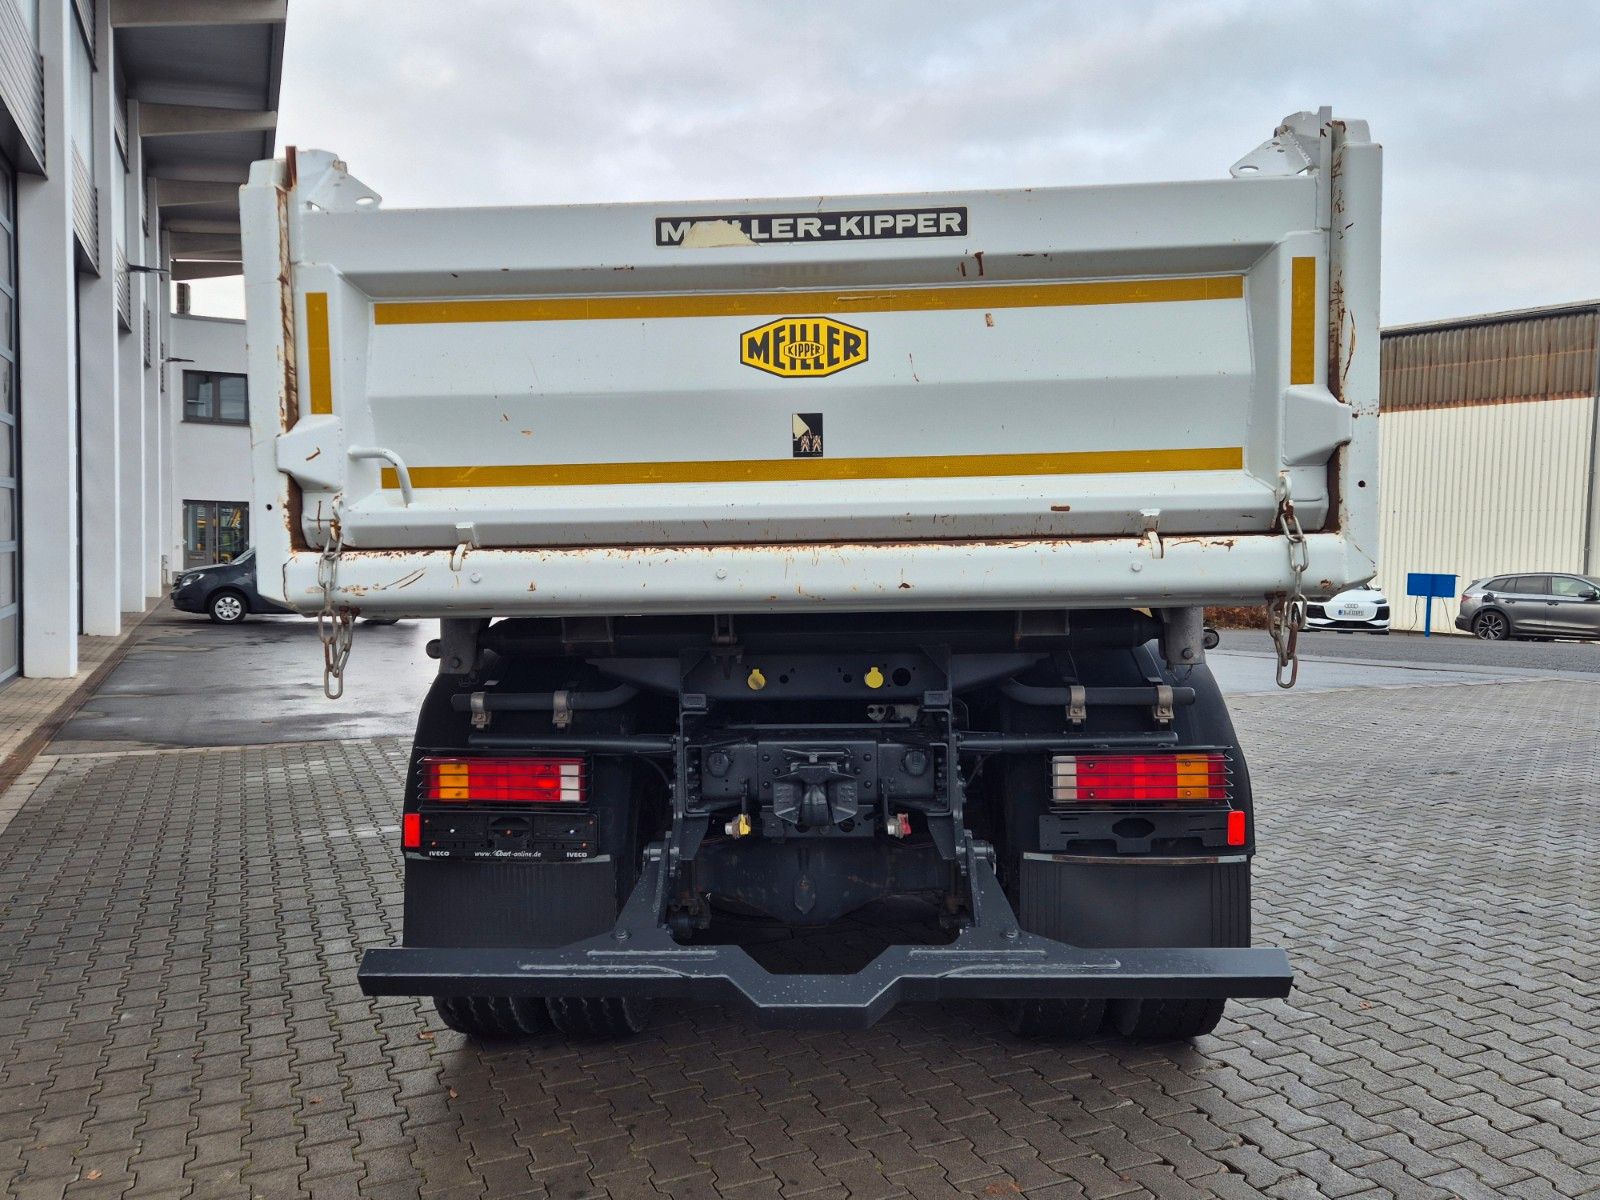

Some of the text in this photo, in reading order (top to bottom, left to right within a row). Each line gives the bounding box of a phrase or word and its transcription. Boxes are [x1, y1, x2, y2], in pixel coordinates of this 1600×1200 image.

[660, 212, 962, 242] MLER-KIPPER
[747, 323, 862, 370] MEILLER
[787, 343, 821, 358] KIPPER
